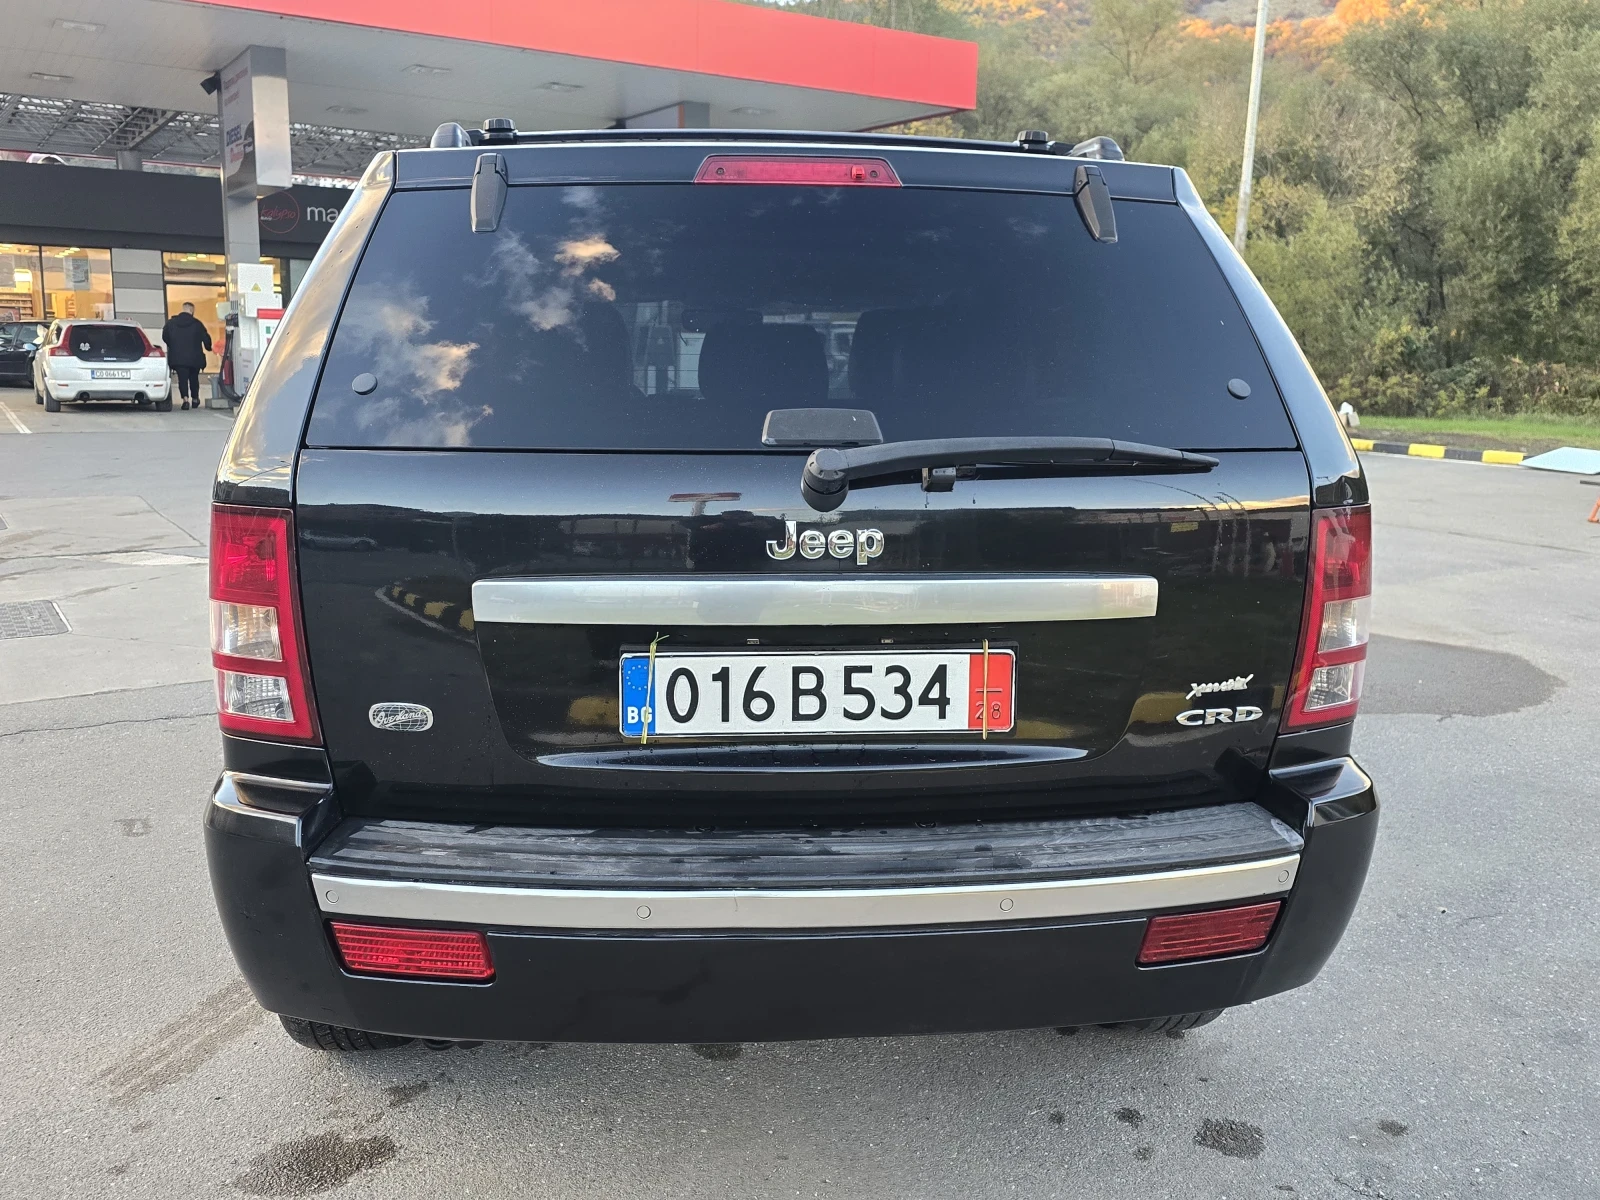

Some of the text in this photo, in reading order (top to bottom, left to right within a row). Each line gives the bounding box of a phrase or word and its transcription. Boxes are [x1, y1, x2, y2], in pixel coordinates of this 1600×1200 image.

[765, 520, 885, 566] Jeep
[375, 708, 427, 727] Overland
[627, 705, 653, 724] BG
[1175, 705, 1264, 727] CRD
